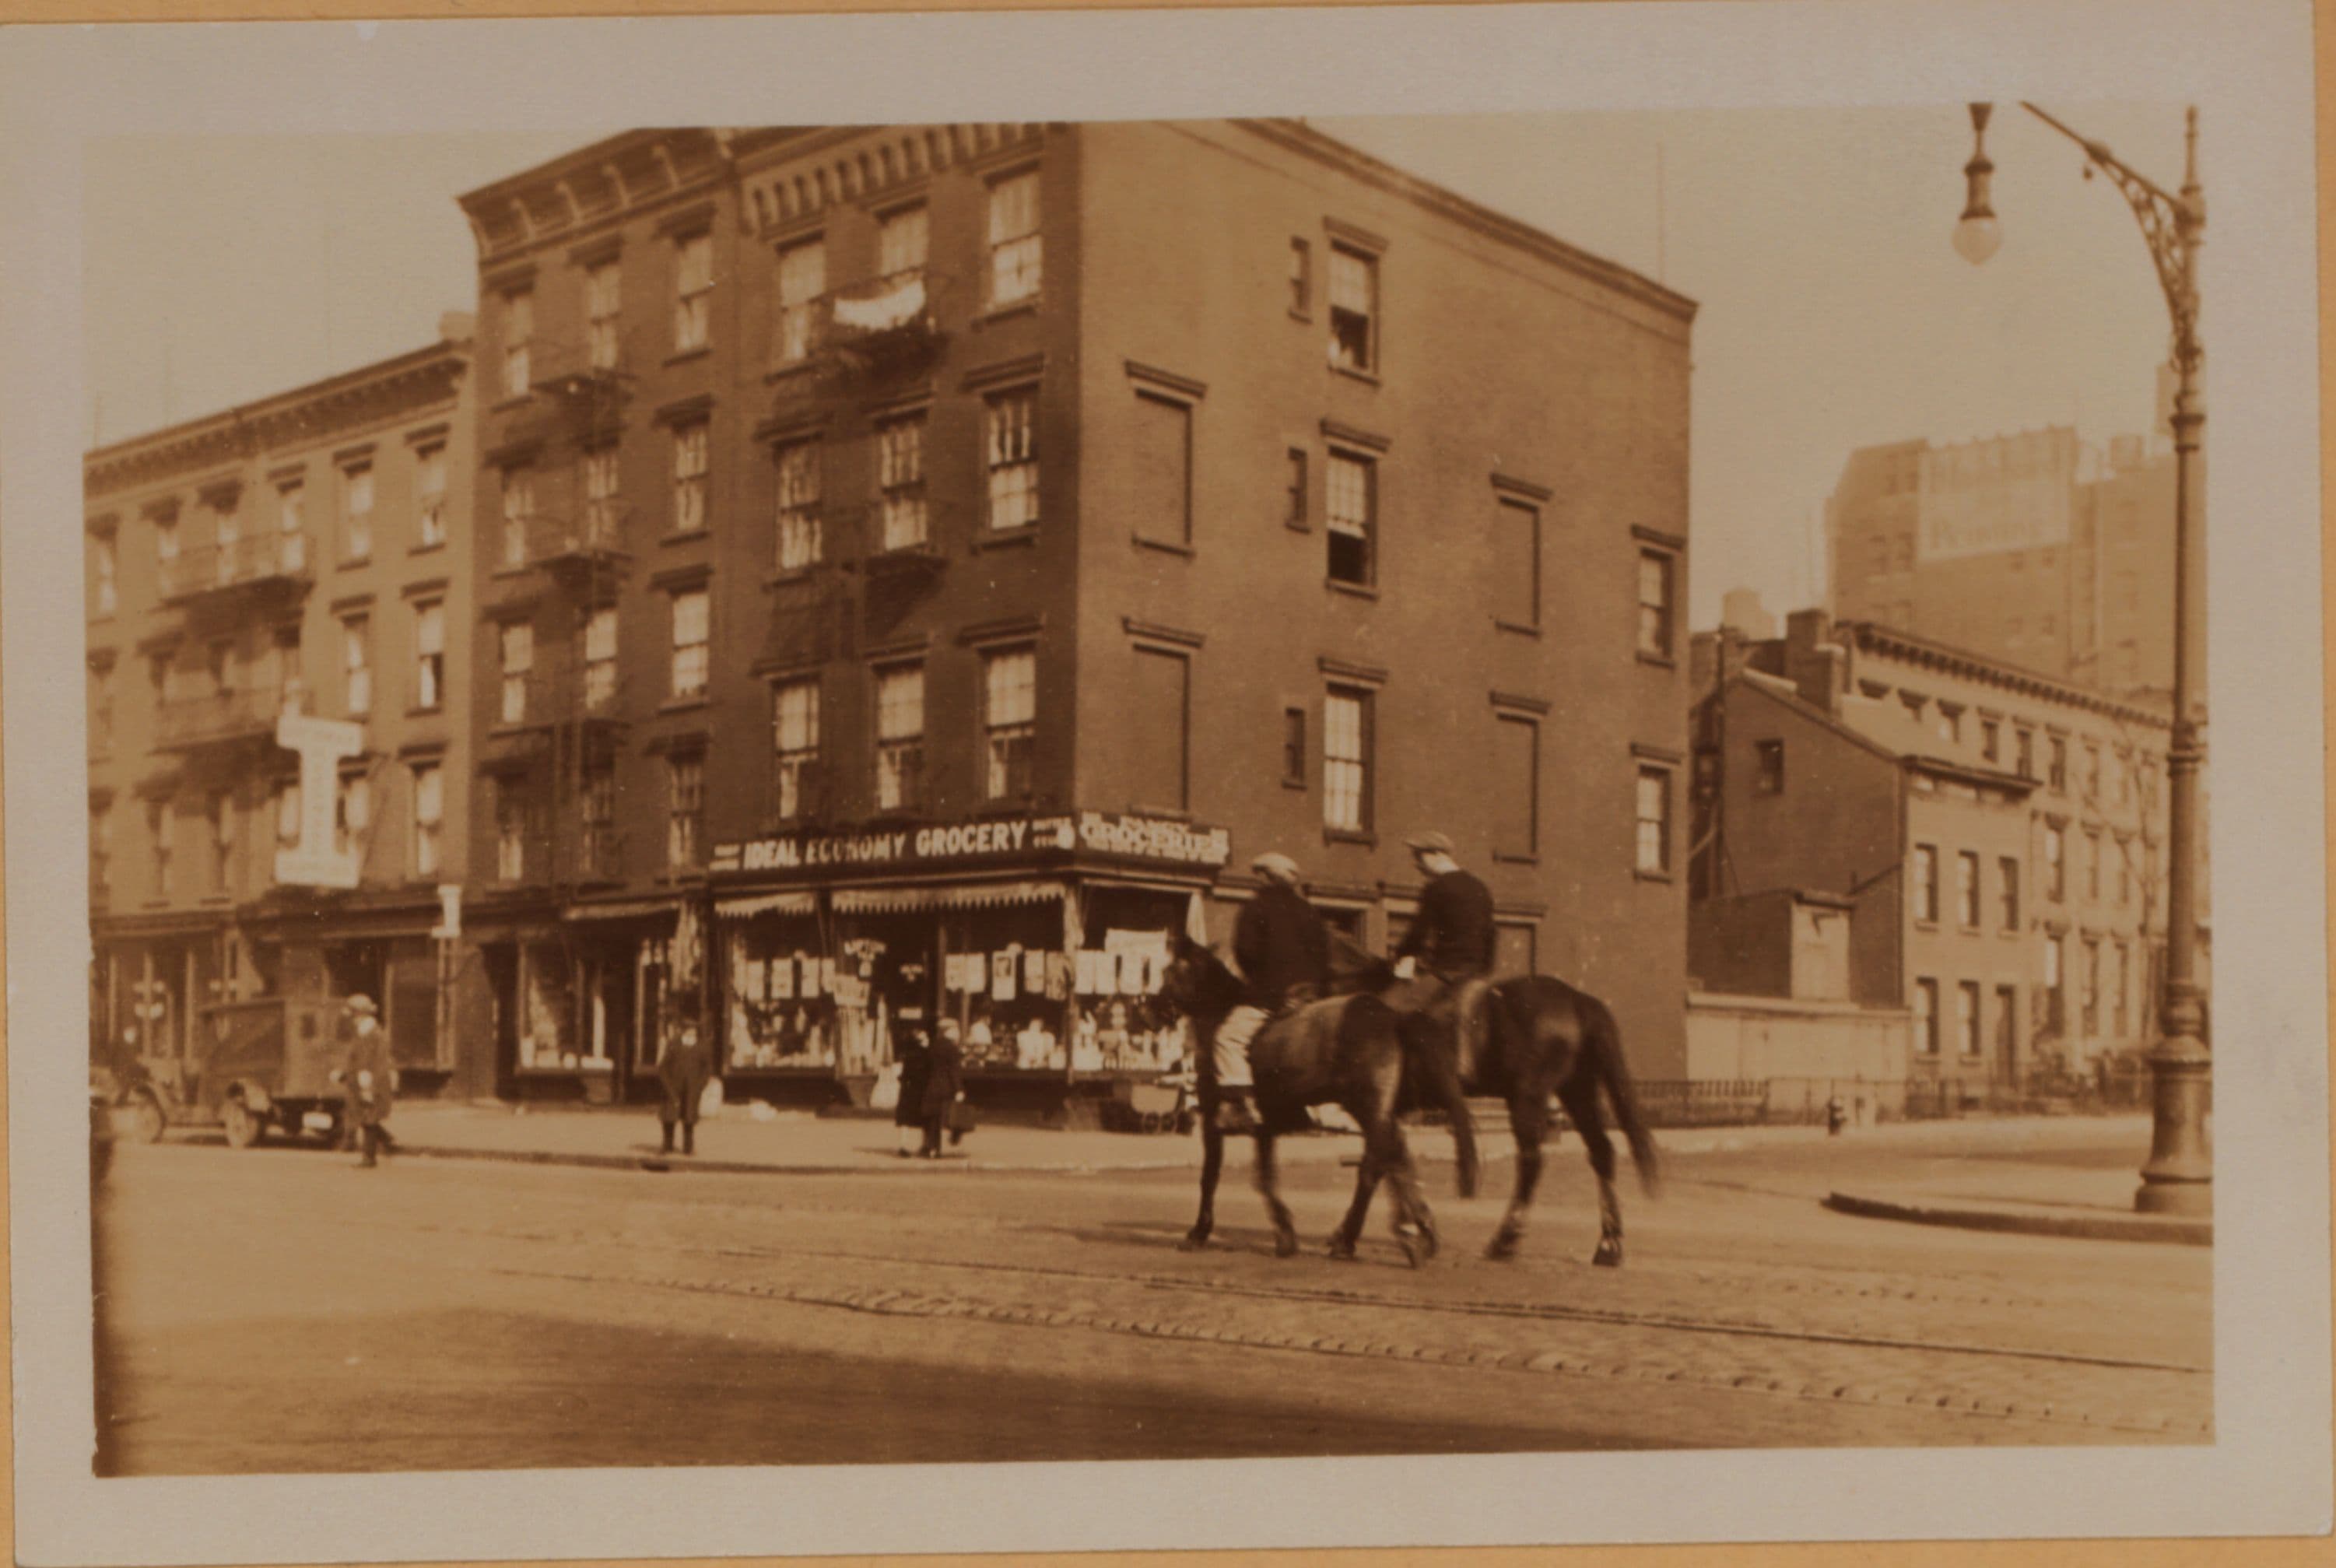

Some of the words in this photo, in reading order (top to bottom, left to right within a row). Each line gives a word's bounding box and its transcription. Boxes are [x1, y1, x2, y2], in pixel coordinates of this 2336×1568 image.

[742, 840, 801, 870] IDEAL
[805, 833, 906, 865] ECONOMY
[916, 820, 1026, 857] GROCERY
